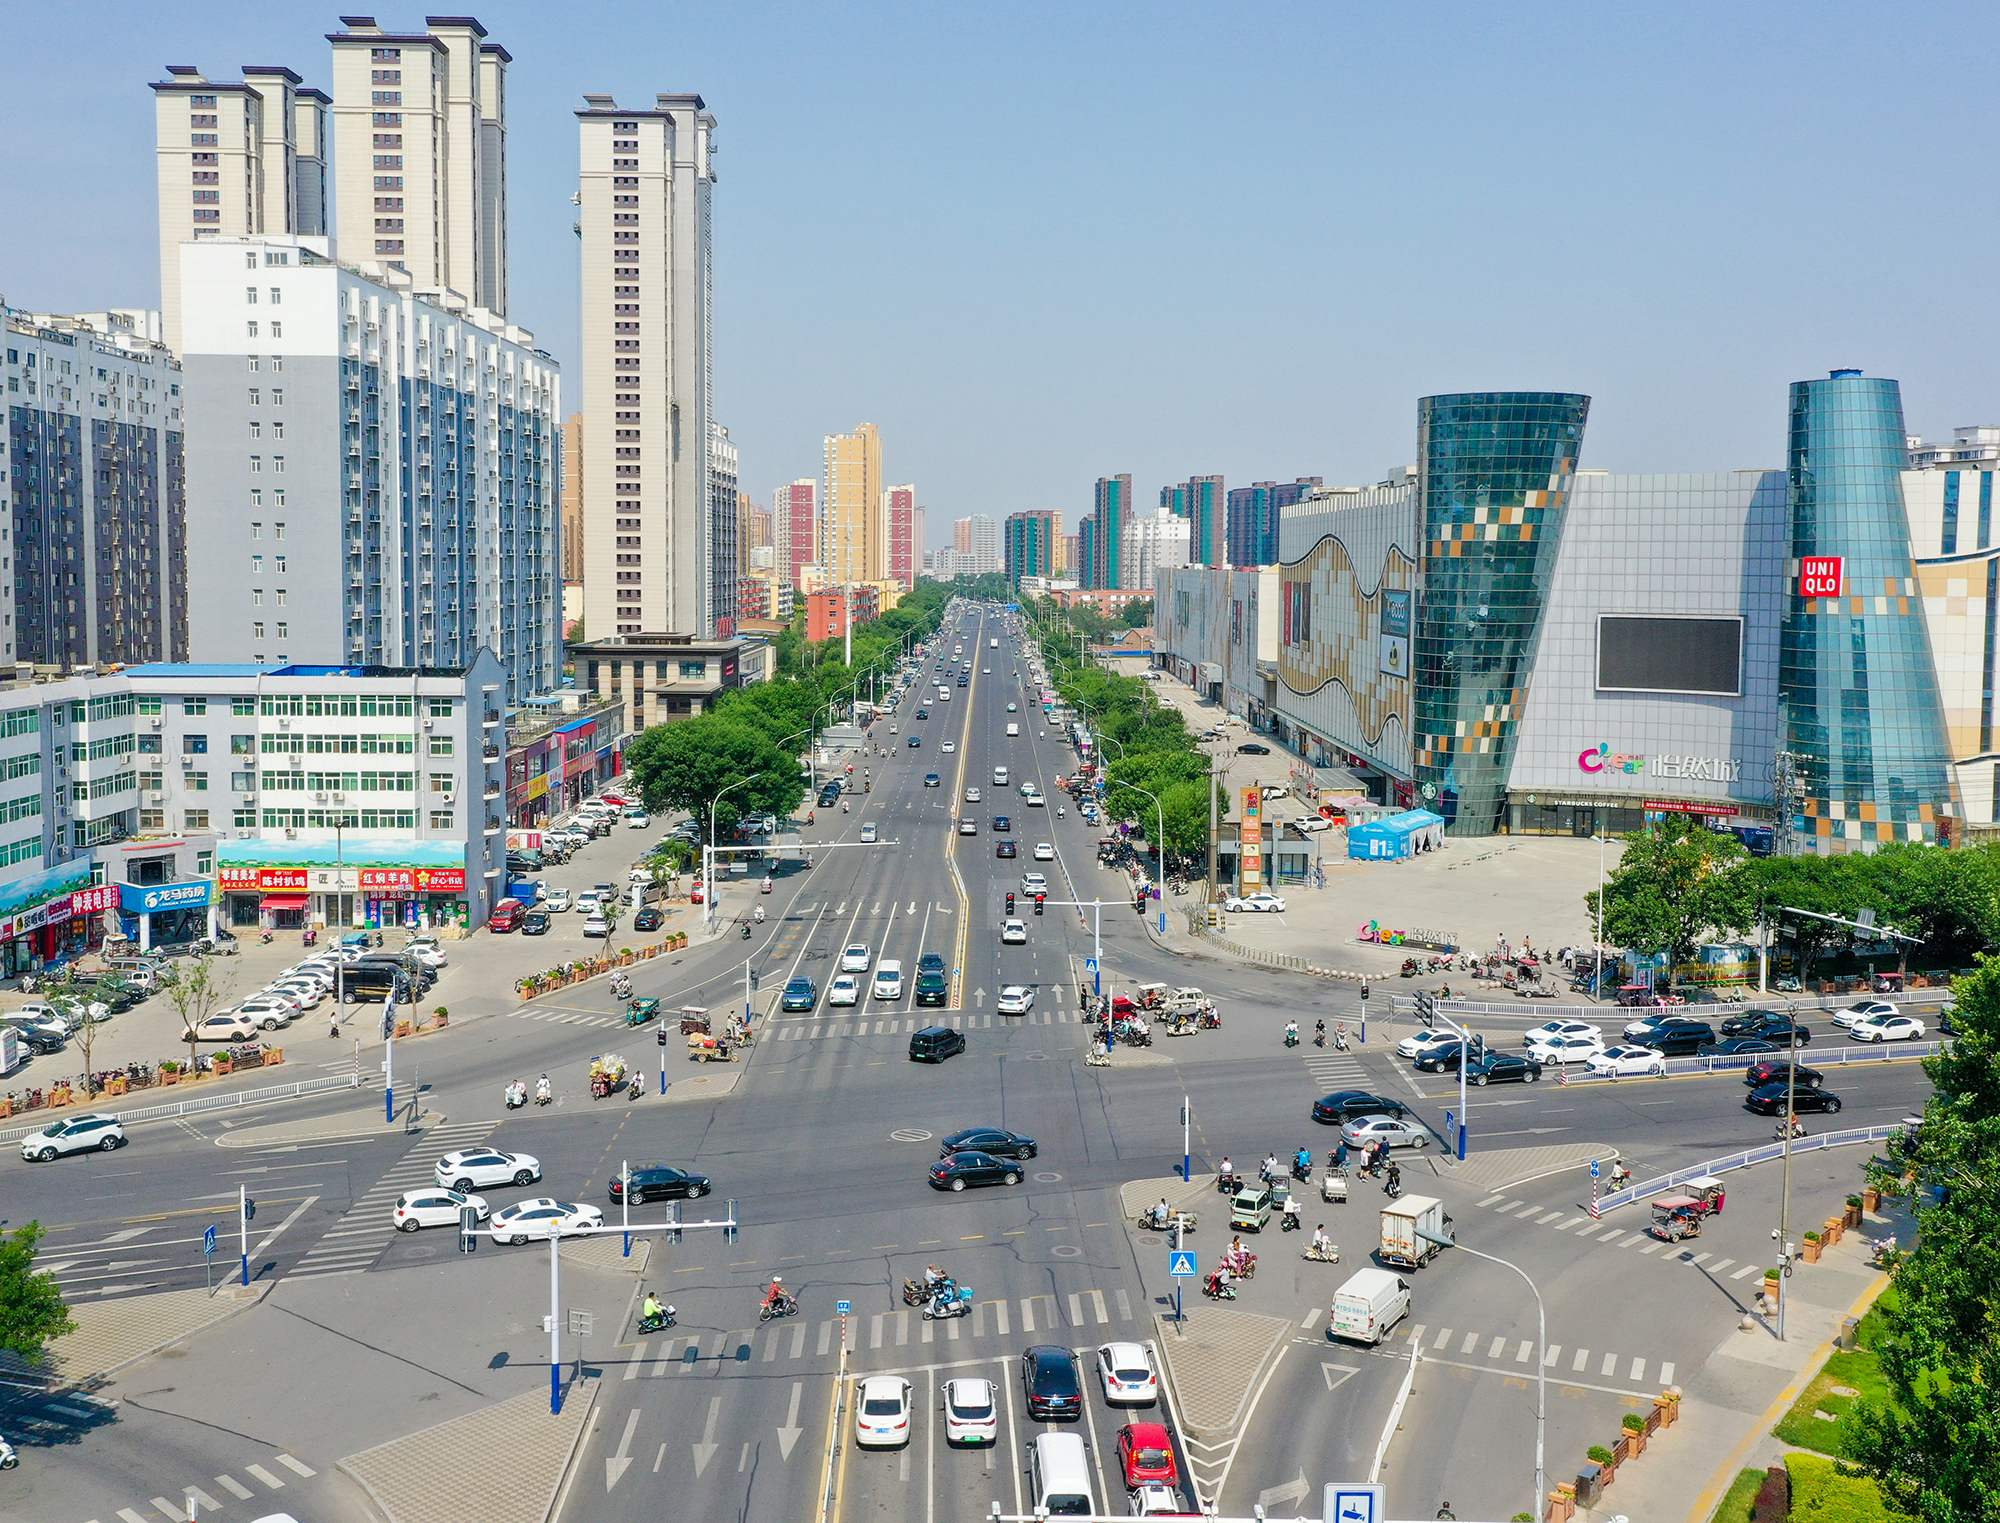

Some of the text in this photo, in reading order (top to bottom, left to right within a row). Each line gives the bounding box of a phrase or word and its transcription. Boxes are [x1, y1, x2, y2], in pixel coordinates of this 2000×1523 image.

[1806, 562, 1834, 576] UNI
[1805, 578, 1836, 594] QLO
[1651, 754, 1742, 783] 怡然城
[1554, 800, 1593, 808] STARBUCKS
[262, 876, 306, 887] 陈村扒鸡
[363, 872, 410, 884] 红焖羊肉
[72, 887, 112, 914] 钟表电器
[158, 885, 206, 902] 龙马药房
